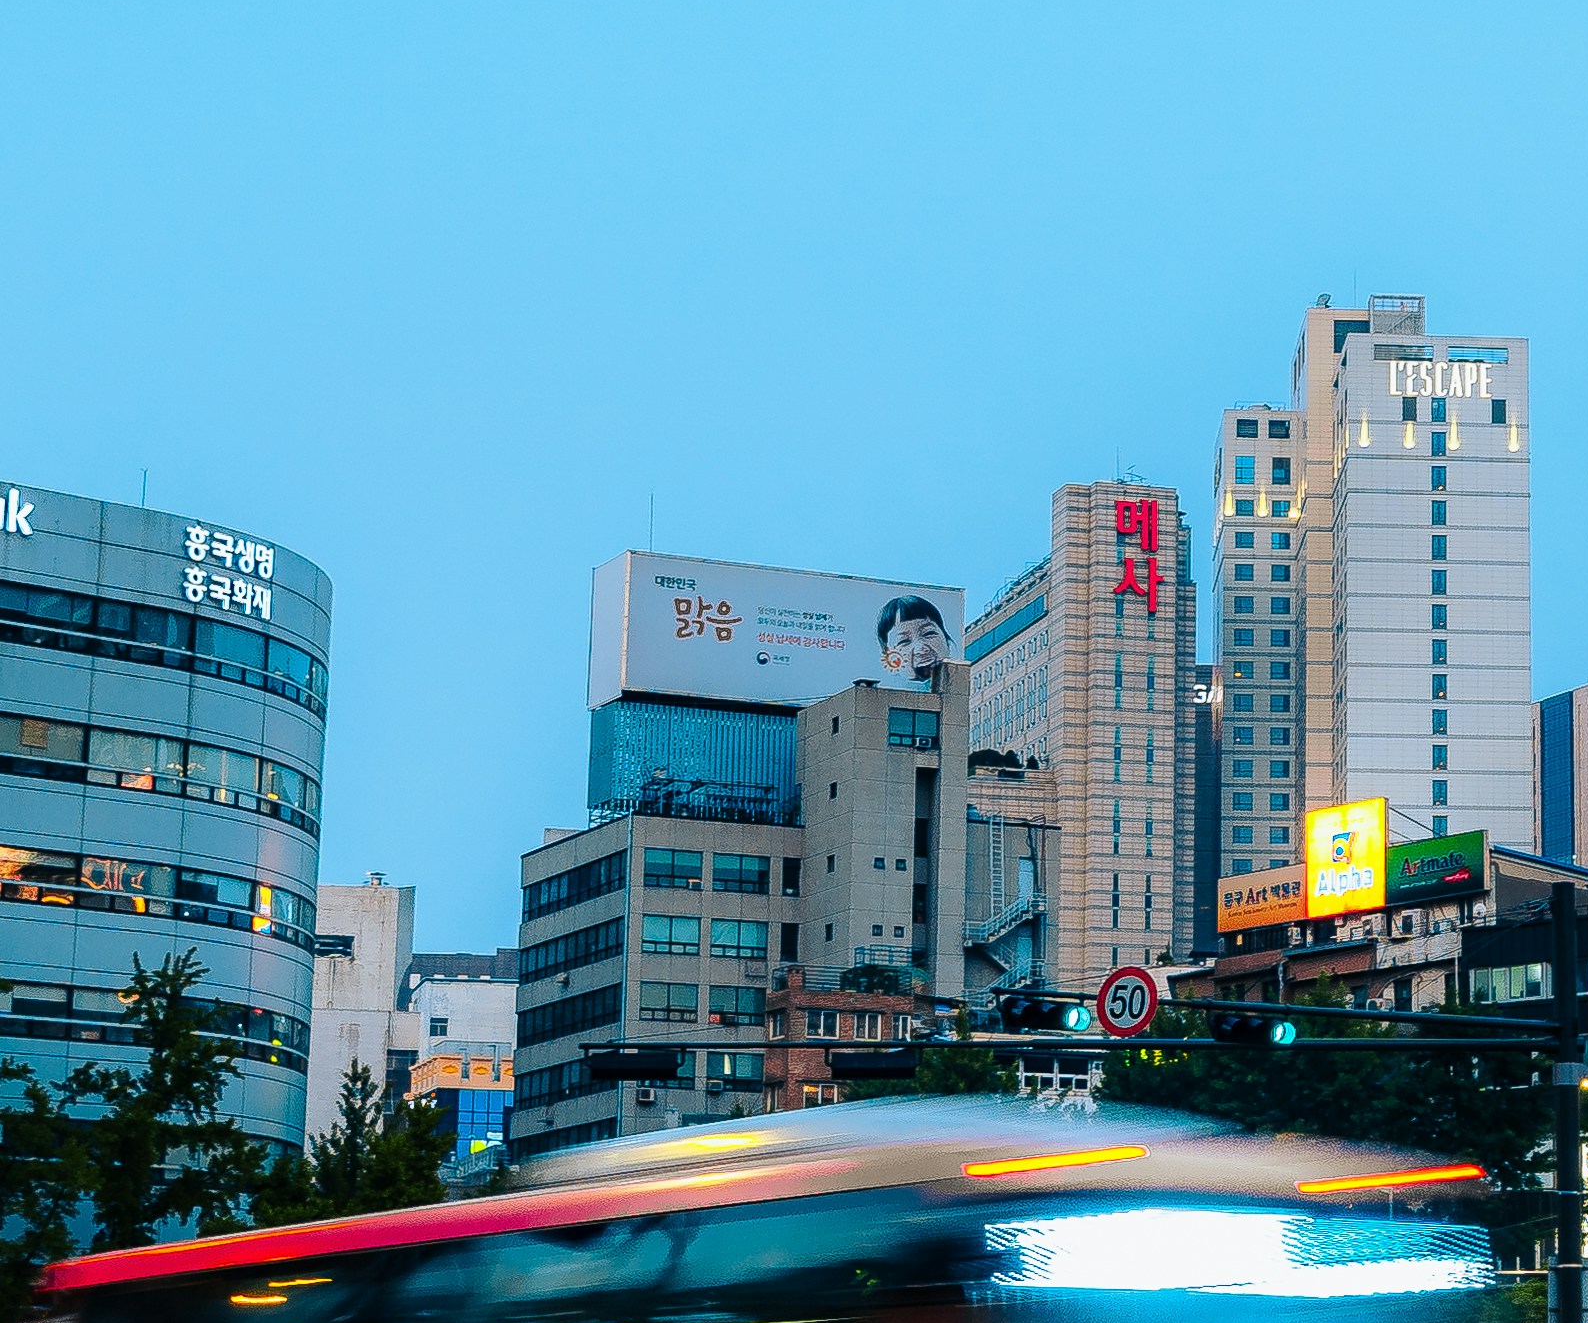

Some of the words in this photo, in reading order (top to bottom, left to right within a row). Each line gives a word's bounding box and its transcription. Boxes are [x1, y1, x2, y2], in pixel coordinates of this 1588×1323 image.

[1389, 360, 1493, 399] L'ESCAPE
[0, 488, 35, 536] k
[184, 525, 275, 579] 흥국생명
[1113, 498, 1165, 613] 메사
[182, 566, 273, 621] 흥국화재
[654, 575, 697, 591] 대한민국
[673, 595, 743, 642] 맑음
[758, 632, 774, 644] 성실
[776, 633, 801, 646] 납세에
[803, 636, 845, 650] 감사합니다
[1316, 865, 1374, 895] Alpha
[1400, 851, 1465, 877] Artmate
[1245, 886, 1268, 905] Art
[1108, 984, 1146, 1020] 50
